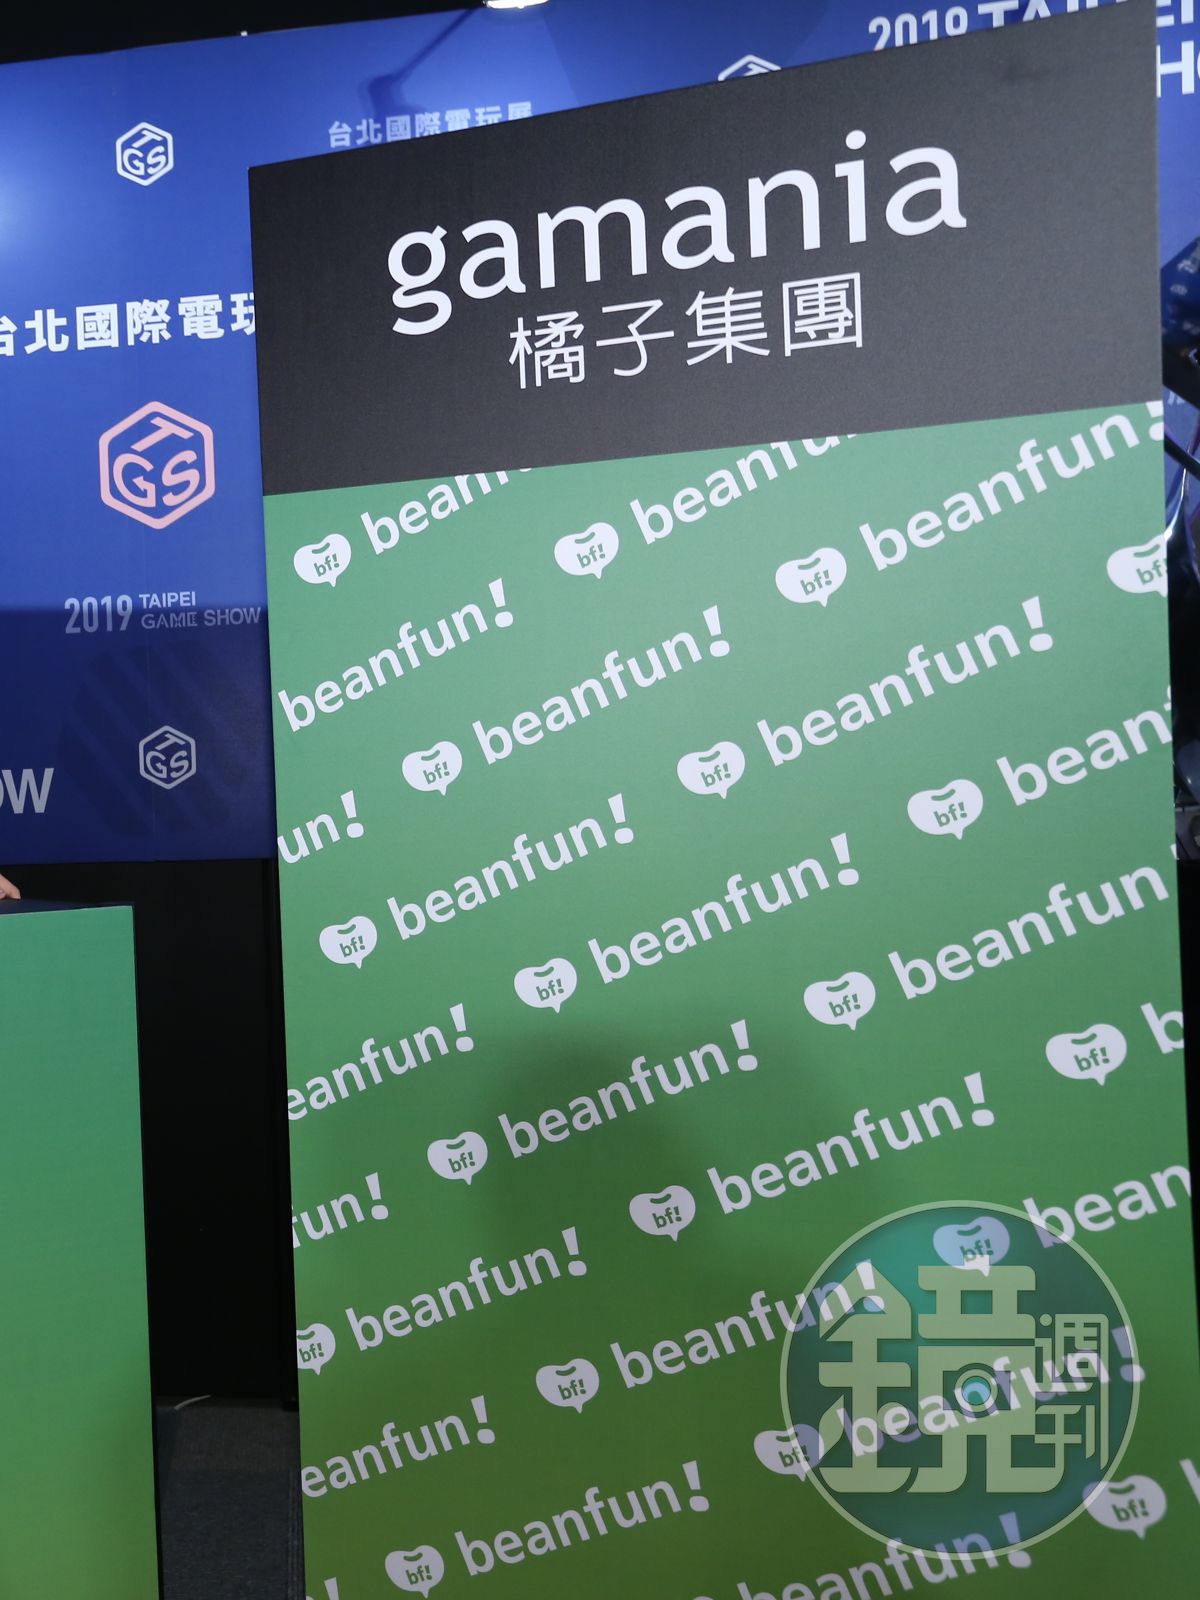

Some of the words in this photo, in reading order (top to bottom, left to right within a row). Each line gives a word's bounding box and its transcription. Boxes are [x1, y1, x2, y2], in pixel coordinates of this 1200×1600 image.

[387, 130, 967, 335] gamania
[508, 272, 864, 389] 橘子集團
[64, 595, 132, 634] 2019
[139, 592, 196, 609] TAIPEI
[141, 611, 197, 629] GAME
[204, 607, 261, 625] SHOW
[313, 553, 340, 577] bf!
[576, 543, 607, 569] bf!
[799, 568, 831, 597] bf!
[277, 577, 514, 732] beanfun!
[423, 761, 451, 785] bf!
[472, 605, 730, 765] beanfun!
[701, 762, 731, 788] bf!
[757, 595, 1053, 767] beanfun!
[339, 935, 366, 958] bf!
[386, 793, 634, 941] beanfun!
[933, 801, 968, 828] bf!
[536, 978, 565, 1002] bf!
[588, 832, 859, 984] beanfun!
[829, 993, 861, 1018] bf!
[888, 843, 1179, 1001] beanfun
[448, 1150, 476, 1174] bf!
[498, 1019, 758, 1159] beanfun!
[1073, 1046, 1110, 1073] bf!
[652, 1206, 682, 1229] bf!
[706, 1072, 995, 1215] beanfun!
[298, 1342, 325, 1364] bf!
[345, 1226, 587, 1351] beanfun!
[557, 1378, 588, 1401] bf!
[610, 1258, 885, 1389] beanfun!
[405, 1563, 433, 1586] bf!
[454, 1459, 710, 1577] beanfun!
[1112, 1497, 1151, 1523] bf!
